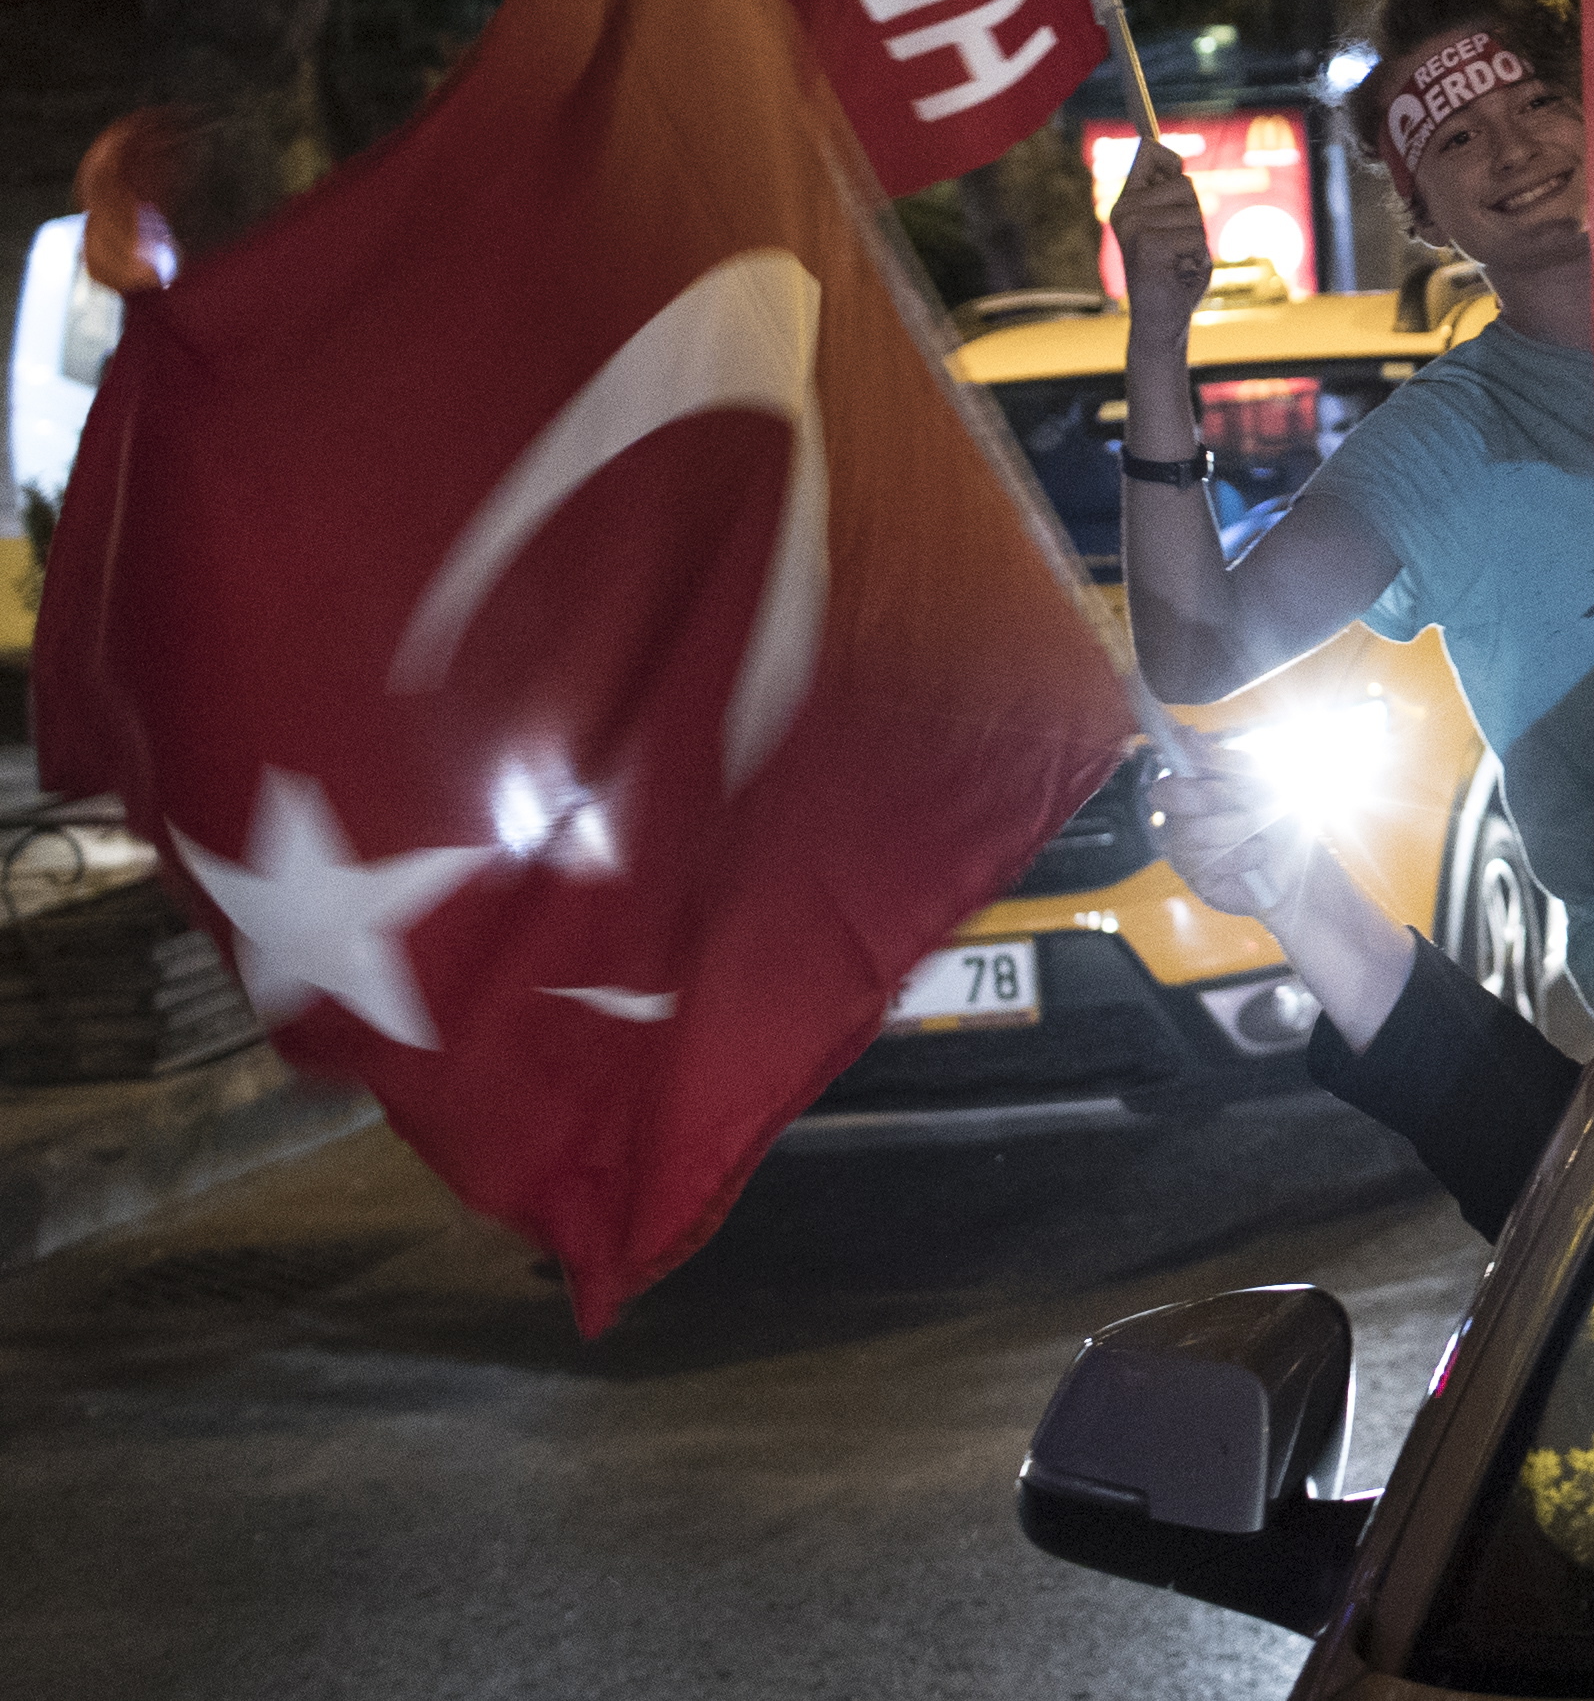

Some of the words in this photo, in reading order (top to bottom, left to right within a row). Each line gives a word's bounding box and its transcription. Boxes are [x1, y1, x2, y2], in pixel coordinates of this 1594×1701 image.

[1414, 33, 1489, 89] RECEP
[1423, 50, 1535, 123] ERDO
[964, 955, 1019, 1001] 78
